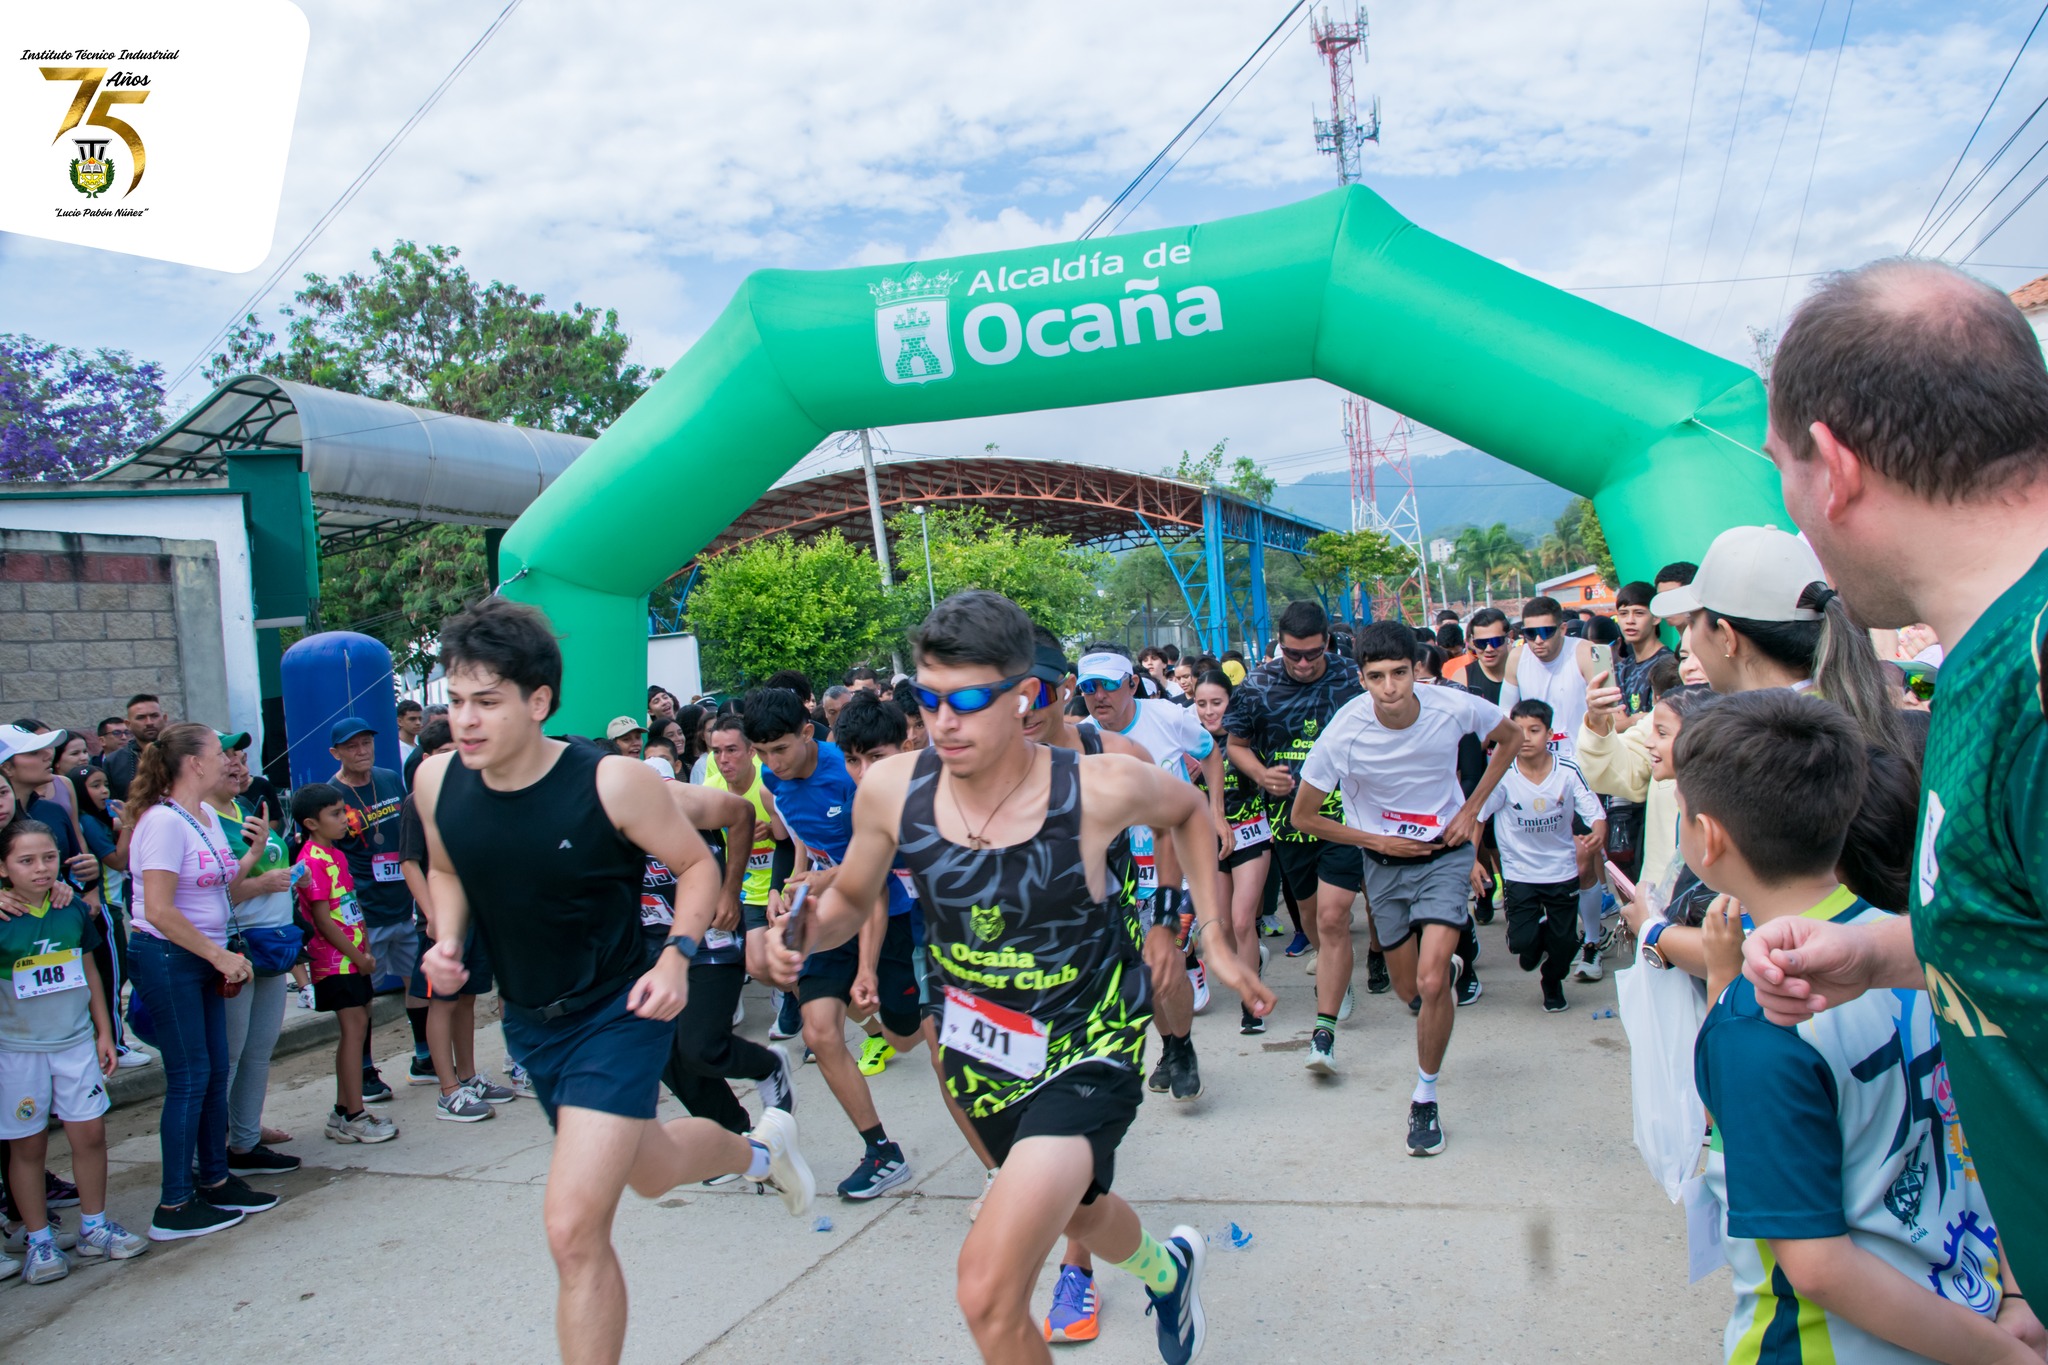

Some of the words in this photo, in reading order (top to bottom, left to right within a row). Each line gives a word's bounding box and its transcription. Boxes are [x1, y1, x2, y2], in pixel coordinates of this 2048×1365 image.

[967, 251, 1124, 296] Alcaldía
[1143, 242, 1191, 269] de
[963, 275, 1224, 365] Ocaña
[1240, 823, 1262, 841] 514
[1517, 813, 1563, 827] Emirates
[1536, 823, 1558, 833] BETTER
[951, 942, 1036, 968] Ocaña
[32, 965, 66, 987] 148
[1013, 963, 1080, 990] Club
[970, 1018, 1011, 1056] 471
[1910, 1226, 1930, 1244] OCAÑA
